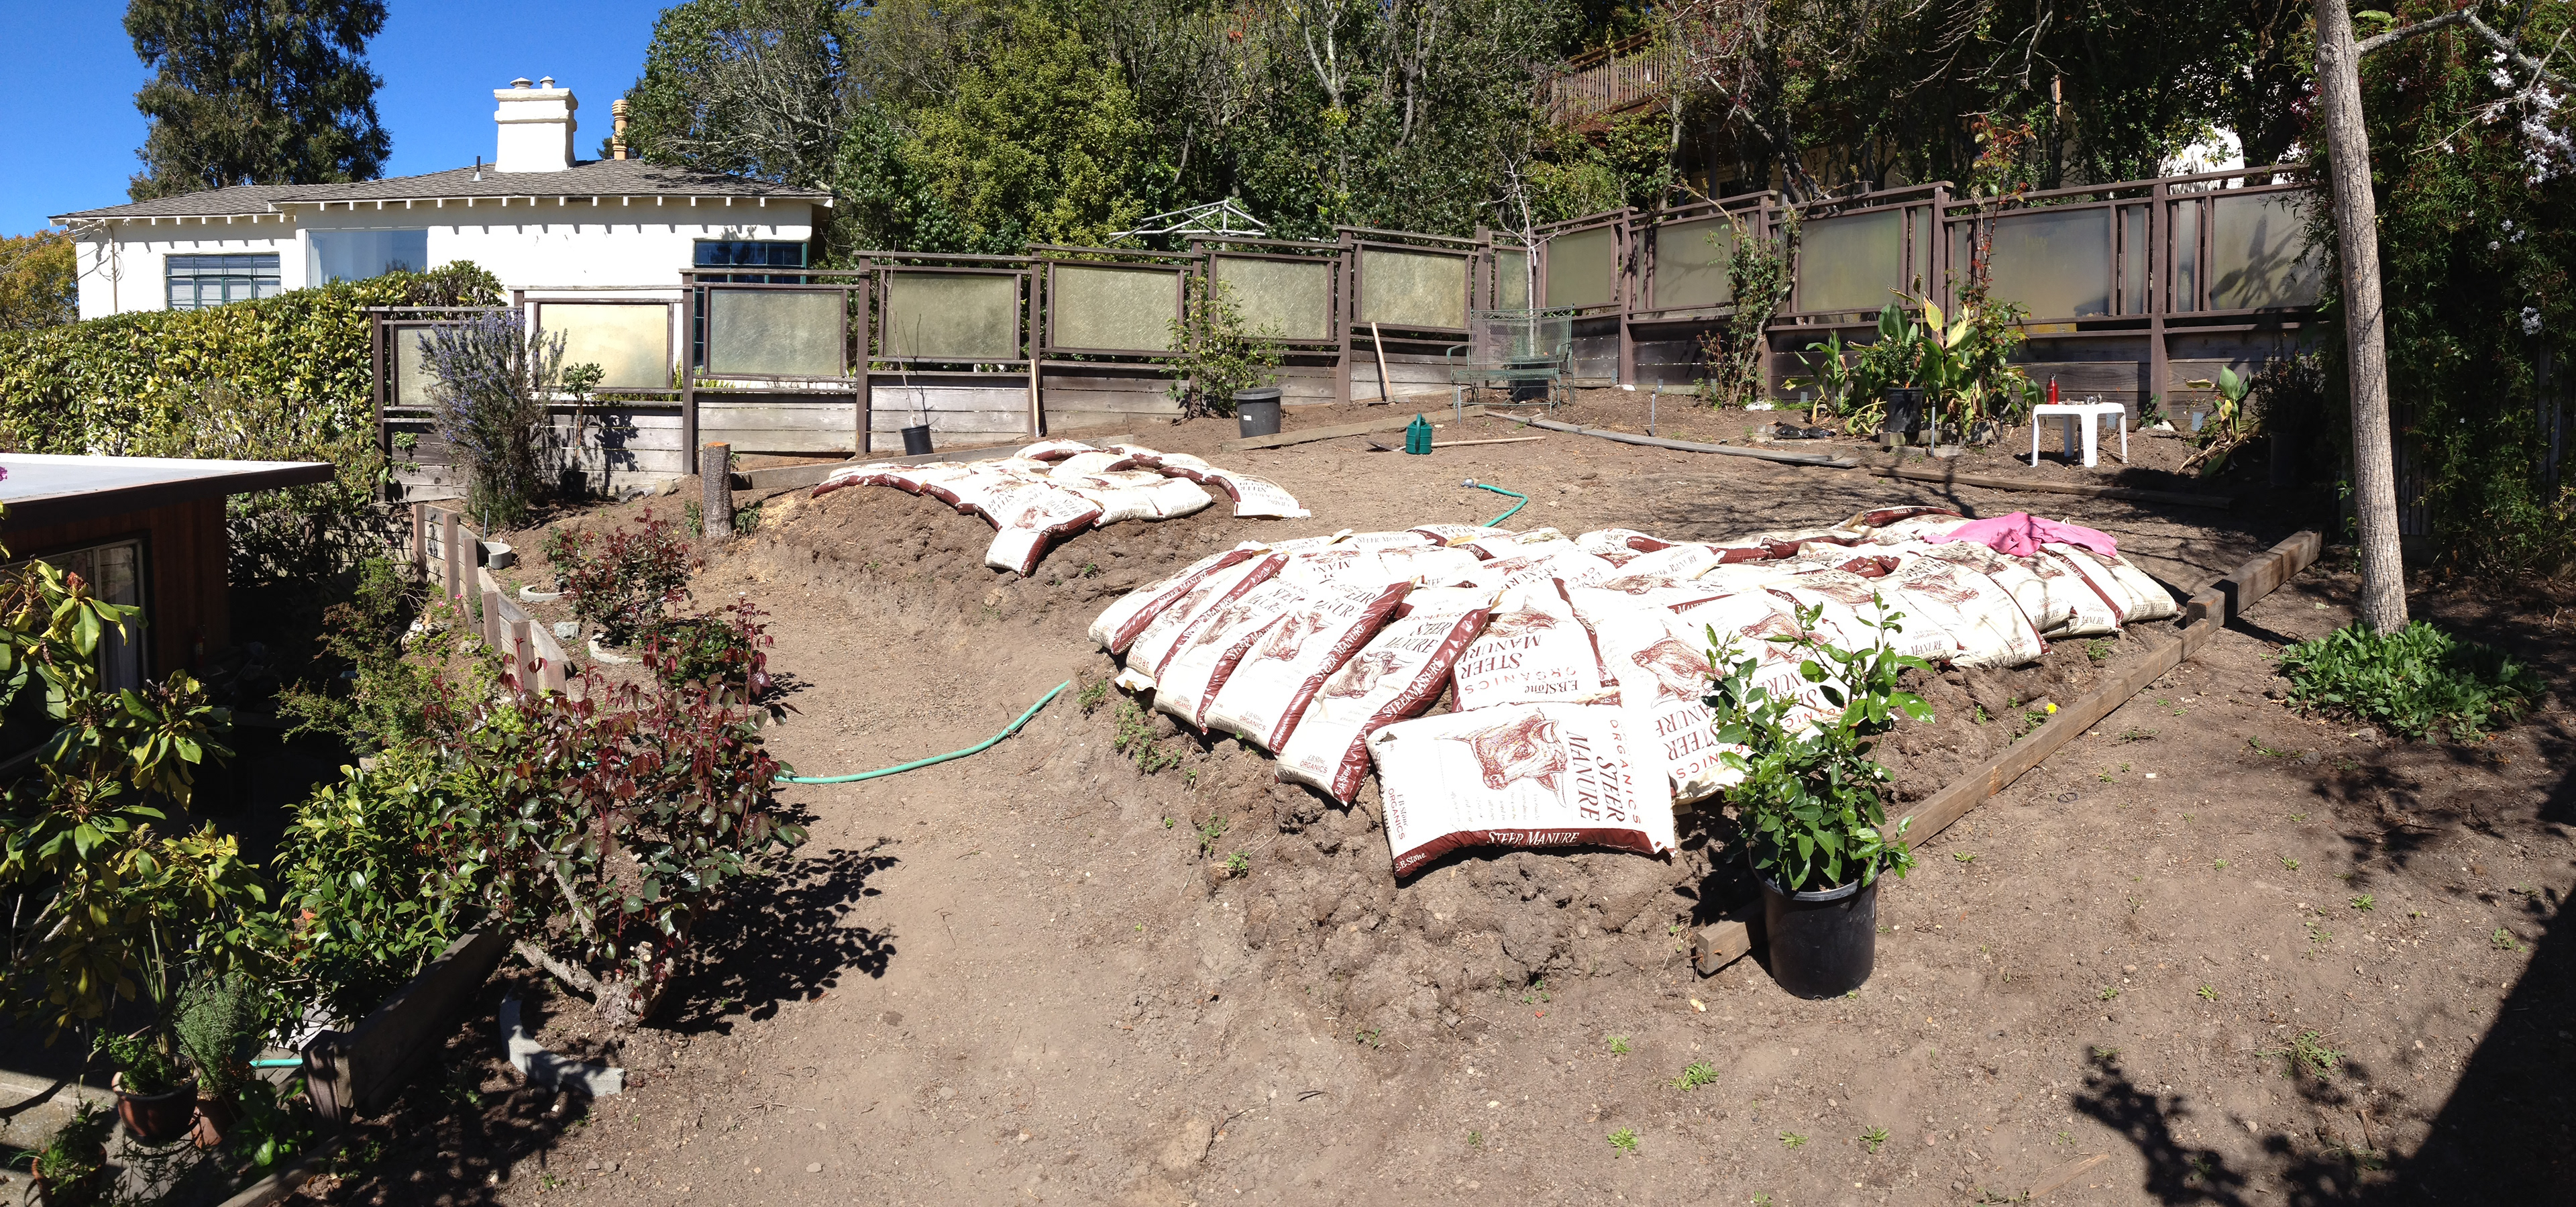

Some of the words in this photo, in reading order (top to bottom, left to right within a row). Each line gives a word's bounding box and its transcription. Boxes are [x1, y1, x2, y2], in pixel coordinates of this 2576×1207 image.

[1180, 570, 1209, 592] MANURE
[2033, 609, 2060, 625] MANURE
[2133, 605, 2149, 613] STEER
[2149, 602, 2169, 611] MANURE
[1410, 621, 1452, 637] STEER
[1114, 634, 1140, 655] ORGANICS
[1314, 655, 1338, 683] STEER
[1335, 622, 1366, 655] MANURE
[1458, 634, 1542, 666] MANURE
[1911, 640, 1943, 656] MANURE
[1460, 653, 1523, 680] STEER
[1383, 693, 1413, 719] STEER
[1411, 657, 1444, 698] MANURE
[1464, 666, 1576, 694] ORGANICS
[1524, 680, 1578, 694] E.B.Stone
[1173, 699, 1192, 711] ORGANICS
[1239, 715, 1267, 731] ORGANICS
[1654, 703, 1719, 737] ANURE
[1299, 760, 1328, 774] ORGANICS
[1676, 743, 1752, 779] GNICS
[1566, 730, 1601, 822] MANURE
[1610, 720, 1642, 825] ORGANICS
[1596, 756, 1625, 823] STEER
[1388, 788, 1405, 840] ORGANICS
[1487, 831, 1524, 845] STEER
[1527, 831, 1580, 845] MANURE
[1395, 851, 1427, 872] E.B.Stone
